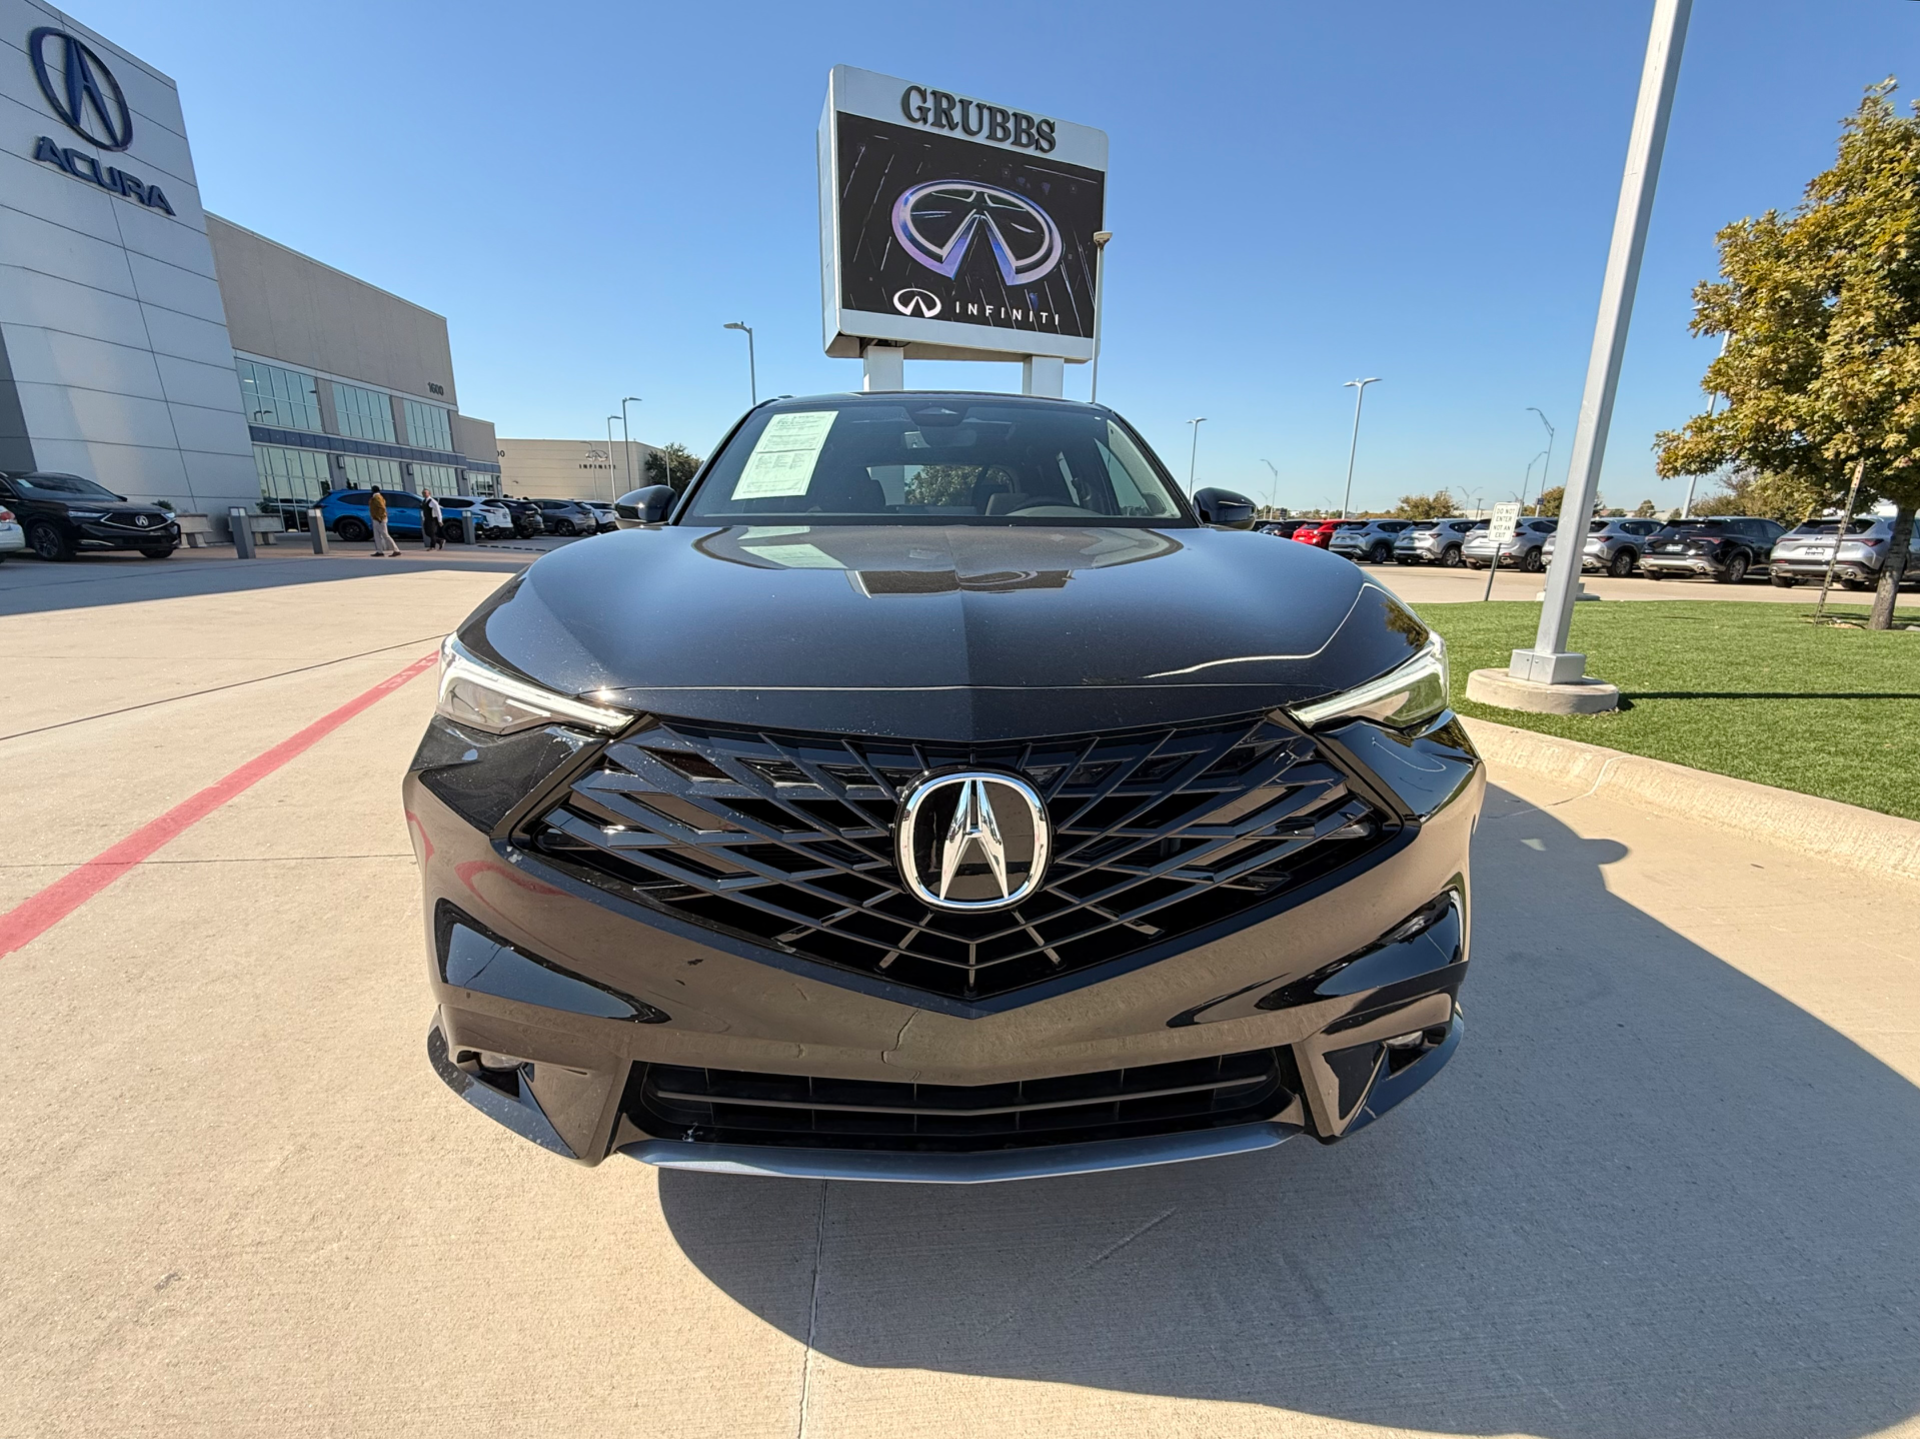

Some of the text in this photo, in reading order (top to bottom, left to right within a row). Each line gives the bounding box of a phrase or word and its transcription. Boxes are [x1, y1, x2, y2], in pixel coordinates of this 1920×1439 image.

[901, 85, 1056, 153] GRUBBS
[34, 136, 176, 216] ACURA
[956, 301, 1059, 326] INFINITI
[427, 381, 445, 396] 1600
